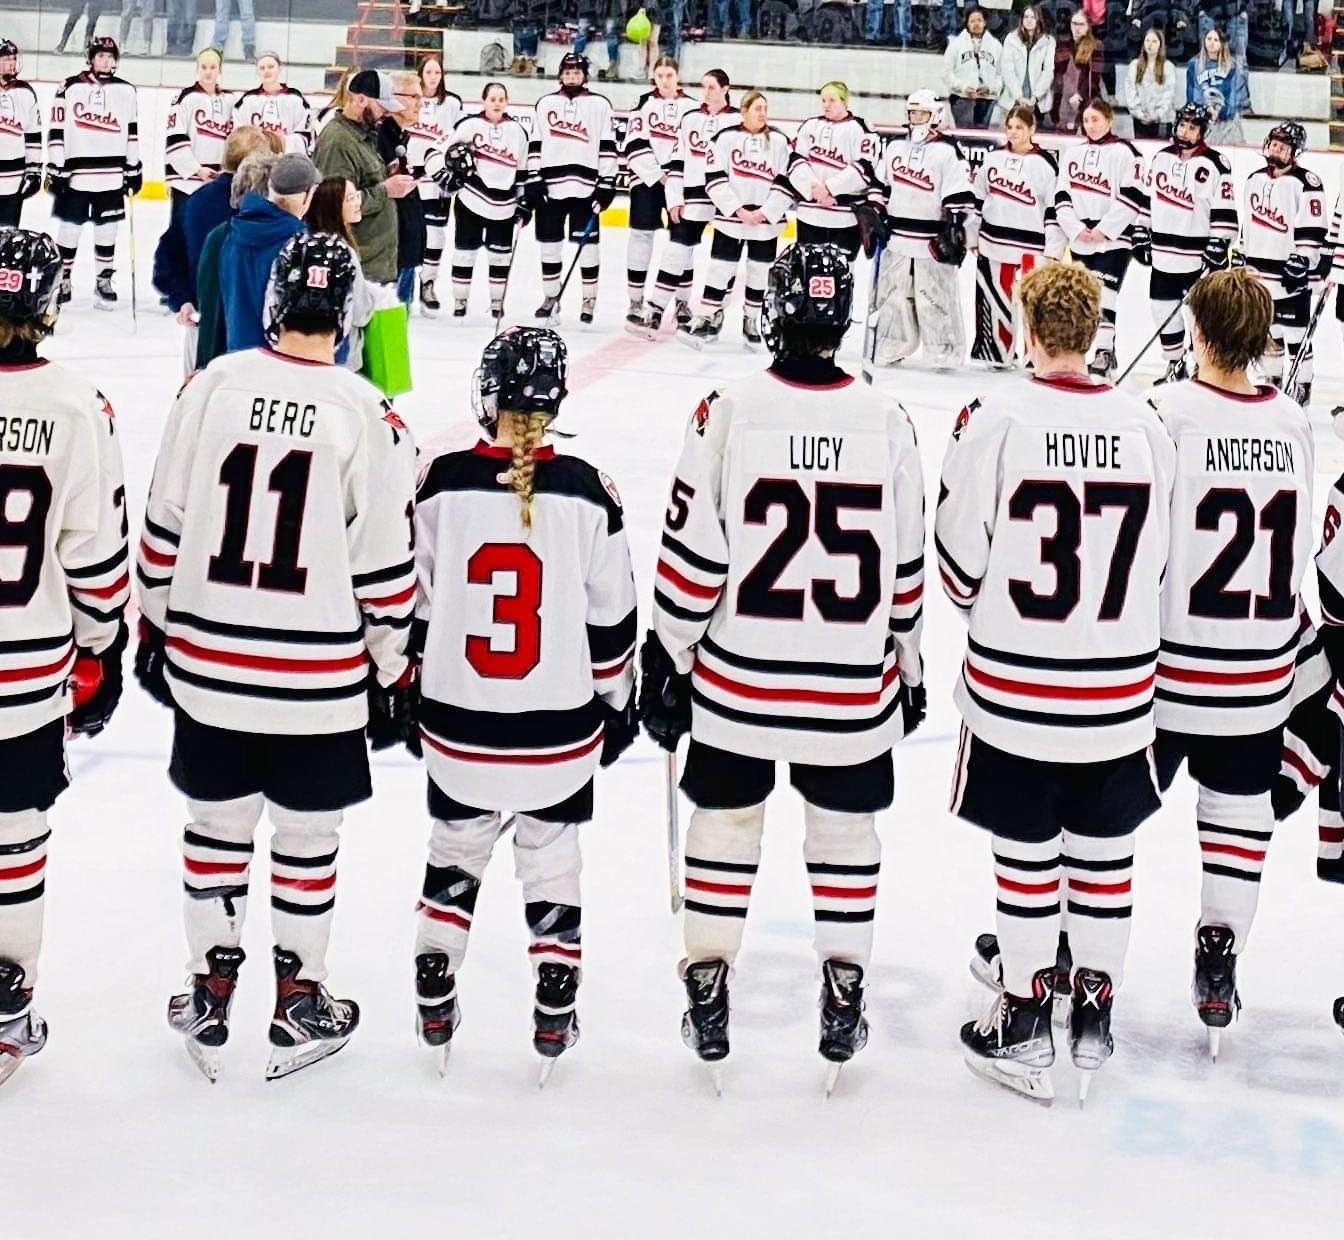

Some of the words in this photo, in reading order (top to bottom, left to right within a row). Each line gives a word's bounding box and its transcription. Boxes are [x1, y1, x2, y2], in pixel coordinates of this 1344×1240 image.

[73, 102, 121, 128] Cards
[891, 155, 932, 184] Cards
[987, 166, 1034, 198] Cards
[1194, 166, 1210, 184] C
[307, 266, 328, 288] 11
[809, 277, 836, 298] 25
[250, 398, 317, 437] BERG
[789, 436, 844, 472] LUCY
[1045, 432, 1123, 470] HOVDE
[1205, 437, 1296, 476] ANDERSON
[207, 443, 314, 596] 11
[736, 477, 883, 623] 25
[1008, 479, 1152, 622] 37
[1188, 487, 1298, 620] 21
[465, 542, 543, 680] 3
